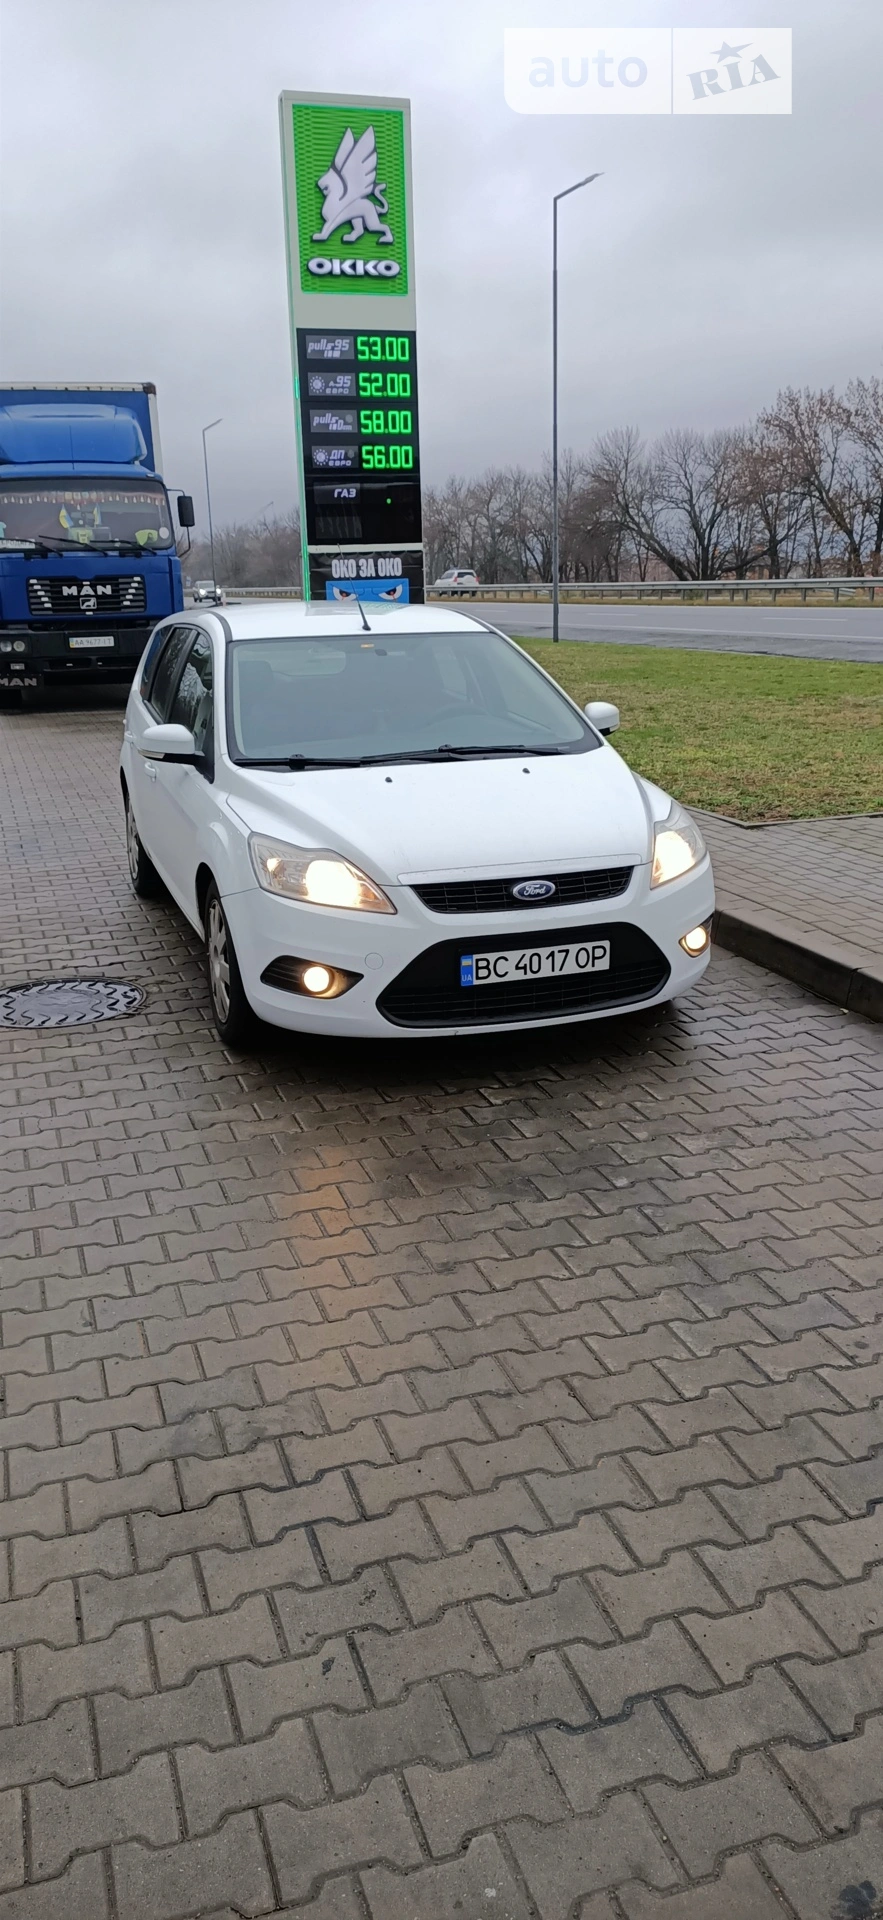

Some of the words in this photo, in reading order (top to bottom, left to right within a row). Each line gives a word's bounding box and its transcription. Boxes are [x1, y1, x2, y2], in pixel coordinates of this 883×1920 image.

[307, 257, 401, 277] OKKO
[357, 336, 409, 361] 53.00
[359, 373, 411, 397] 52.00
[361, 410, 412, 434] 58.00
[362, 445, 413, 469] 56.00
[334, 488, 357, 498] ГАЗ
[331, 559, 357, 578] ОКО
[358, 558, 376, 578] ЗА
[377, 557, 403, 577] ОКО
[62, 585, 112, 596] MAN
[523, 884, 547, 896] Ford
[475, 956, 509, 980] BC
[515, 949, 570, 975] 4017
[575, 945, 607, 969] OP
